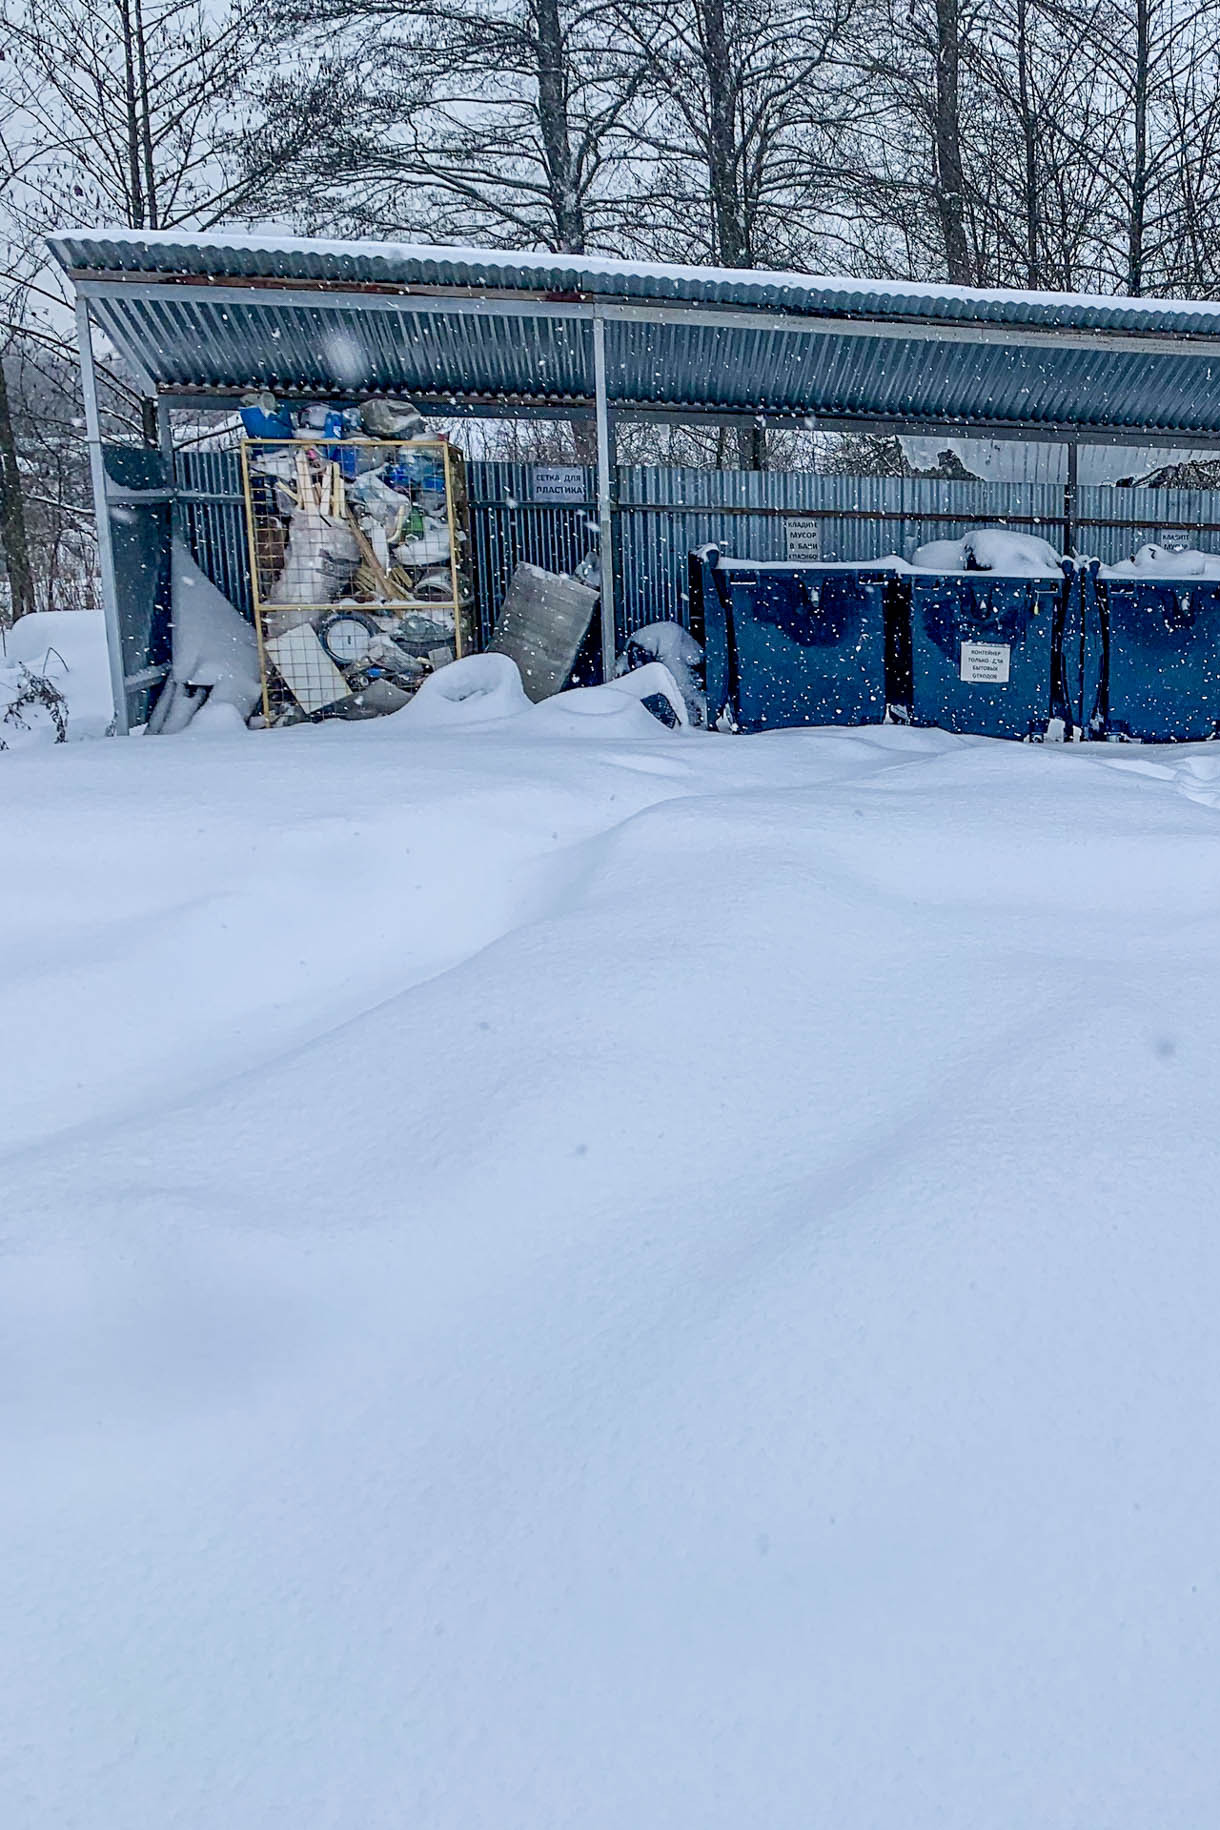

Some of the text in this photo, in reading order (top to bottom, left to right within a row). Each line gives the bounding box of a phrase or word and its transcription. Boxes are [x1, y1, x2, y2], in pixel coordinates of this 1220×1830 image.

[564, 474, 581, 482] ДЛЯ
[536, 486, 583, 494] ПЛАСТИКА
[790, 531, 817, 539] МУСОР
